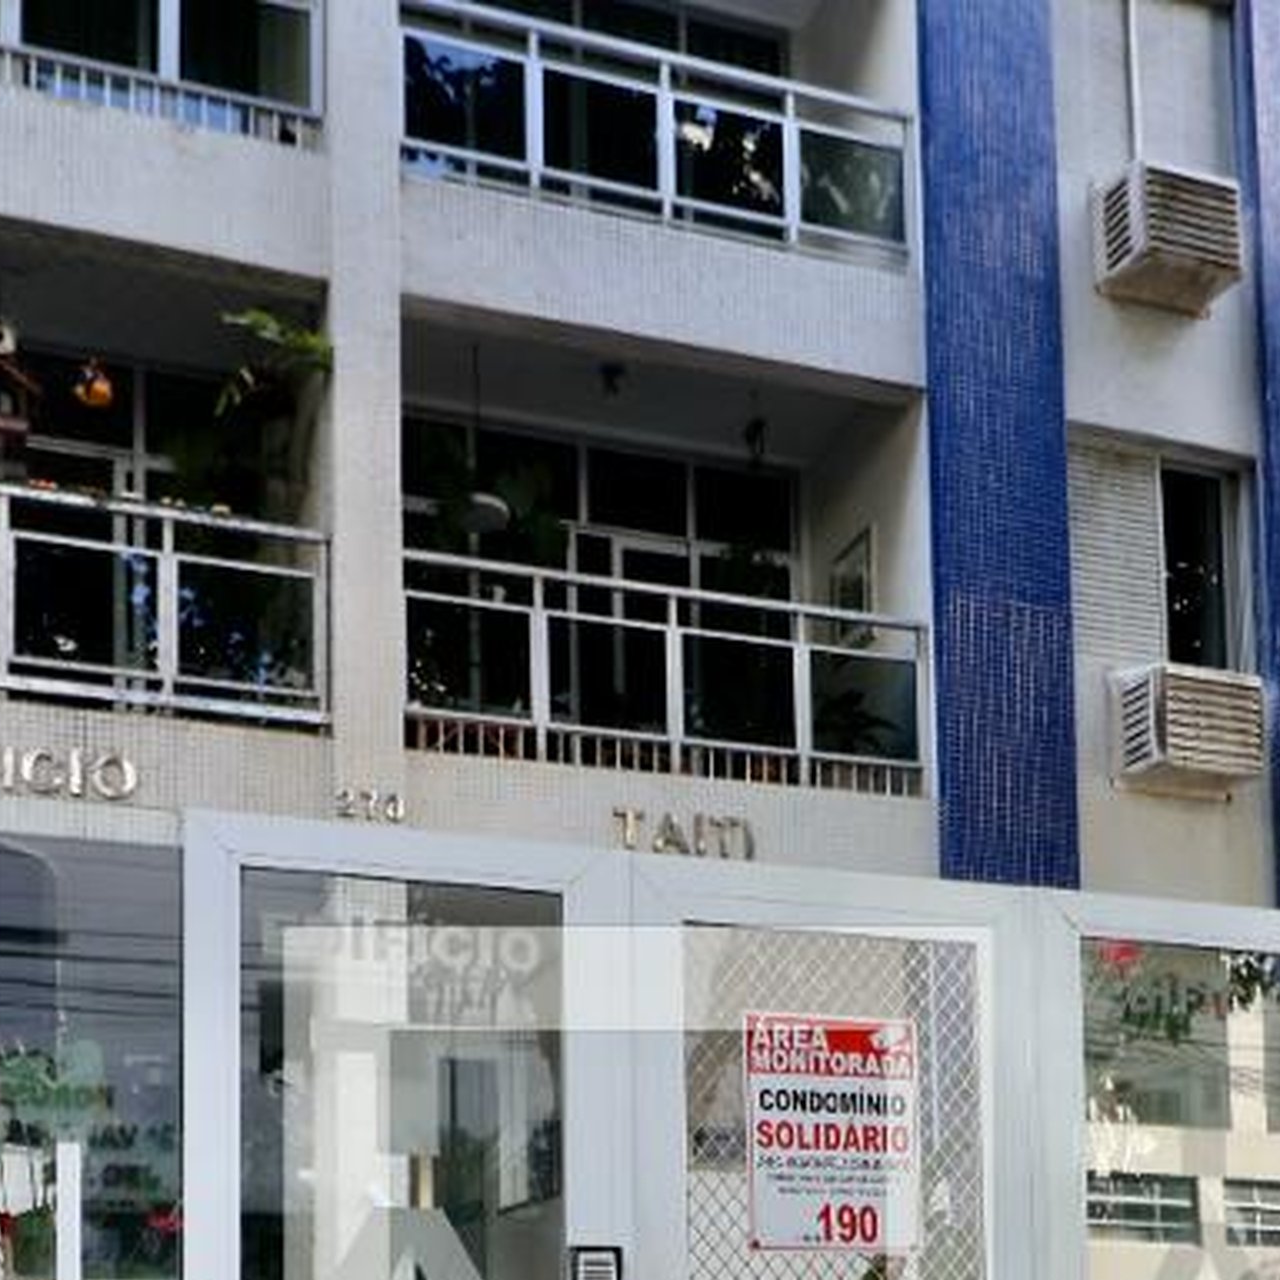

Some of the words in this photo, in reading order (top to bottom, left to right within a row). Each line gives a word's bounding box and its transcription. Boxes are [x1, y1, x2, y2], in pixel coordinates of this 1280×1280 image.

[751, 1049, 911, 1078] MONITORADA
[759, 1085, 906, 1116] CONDOMÍNIO
[816, 1202, 878, 1244] 190
